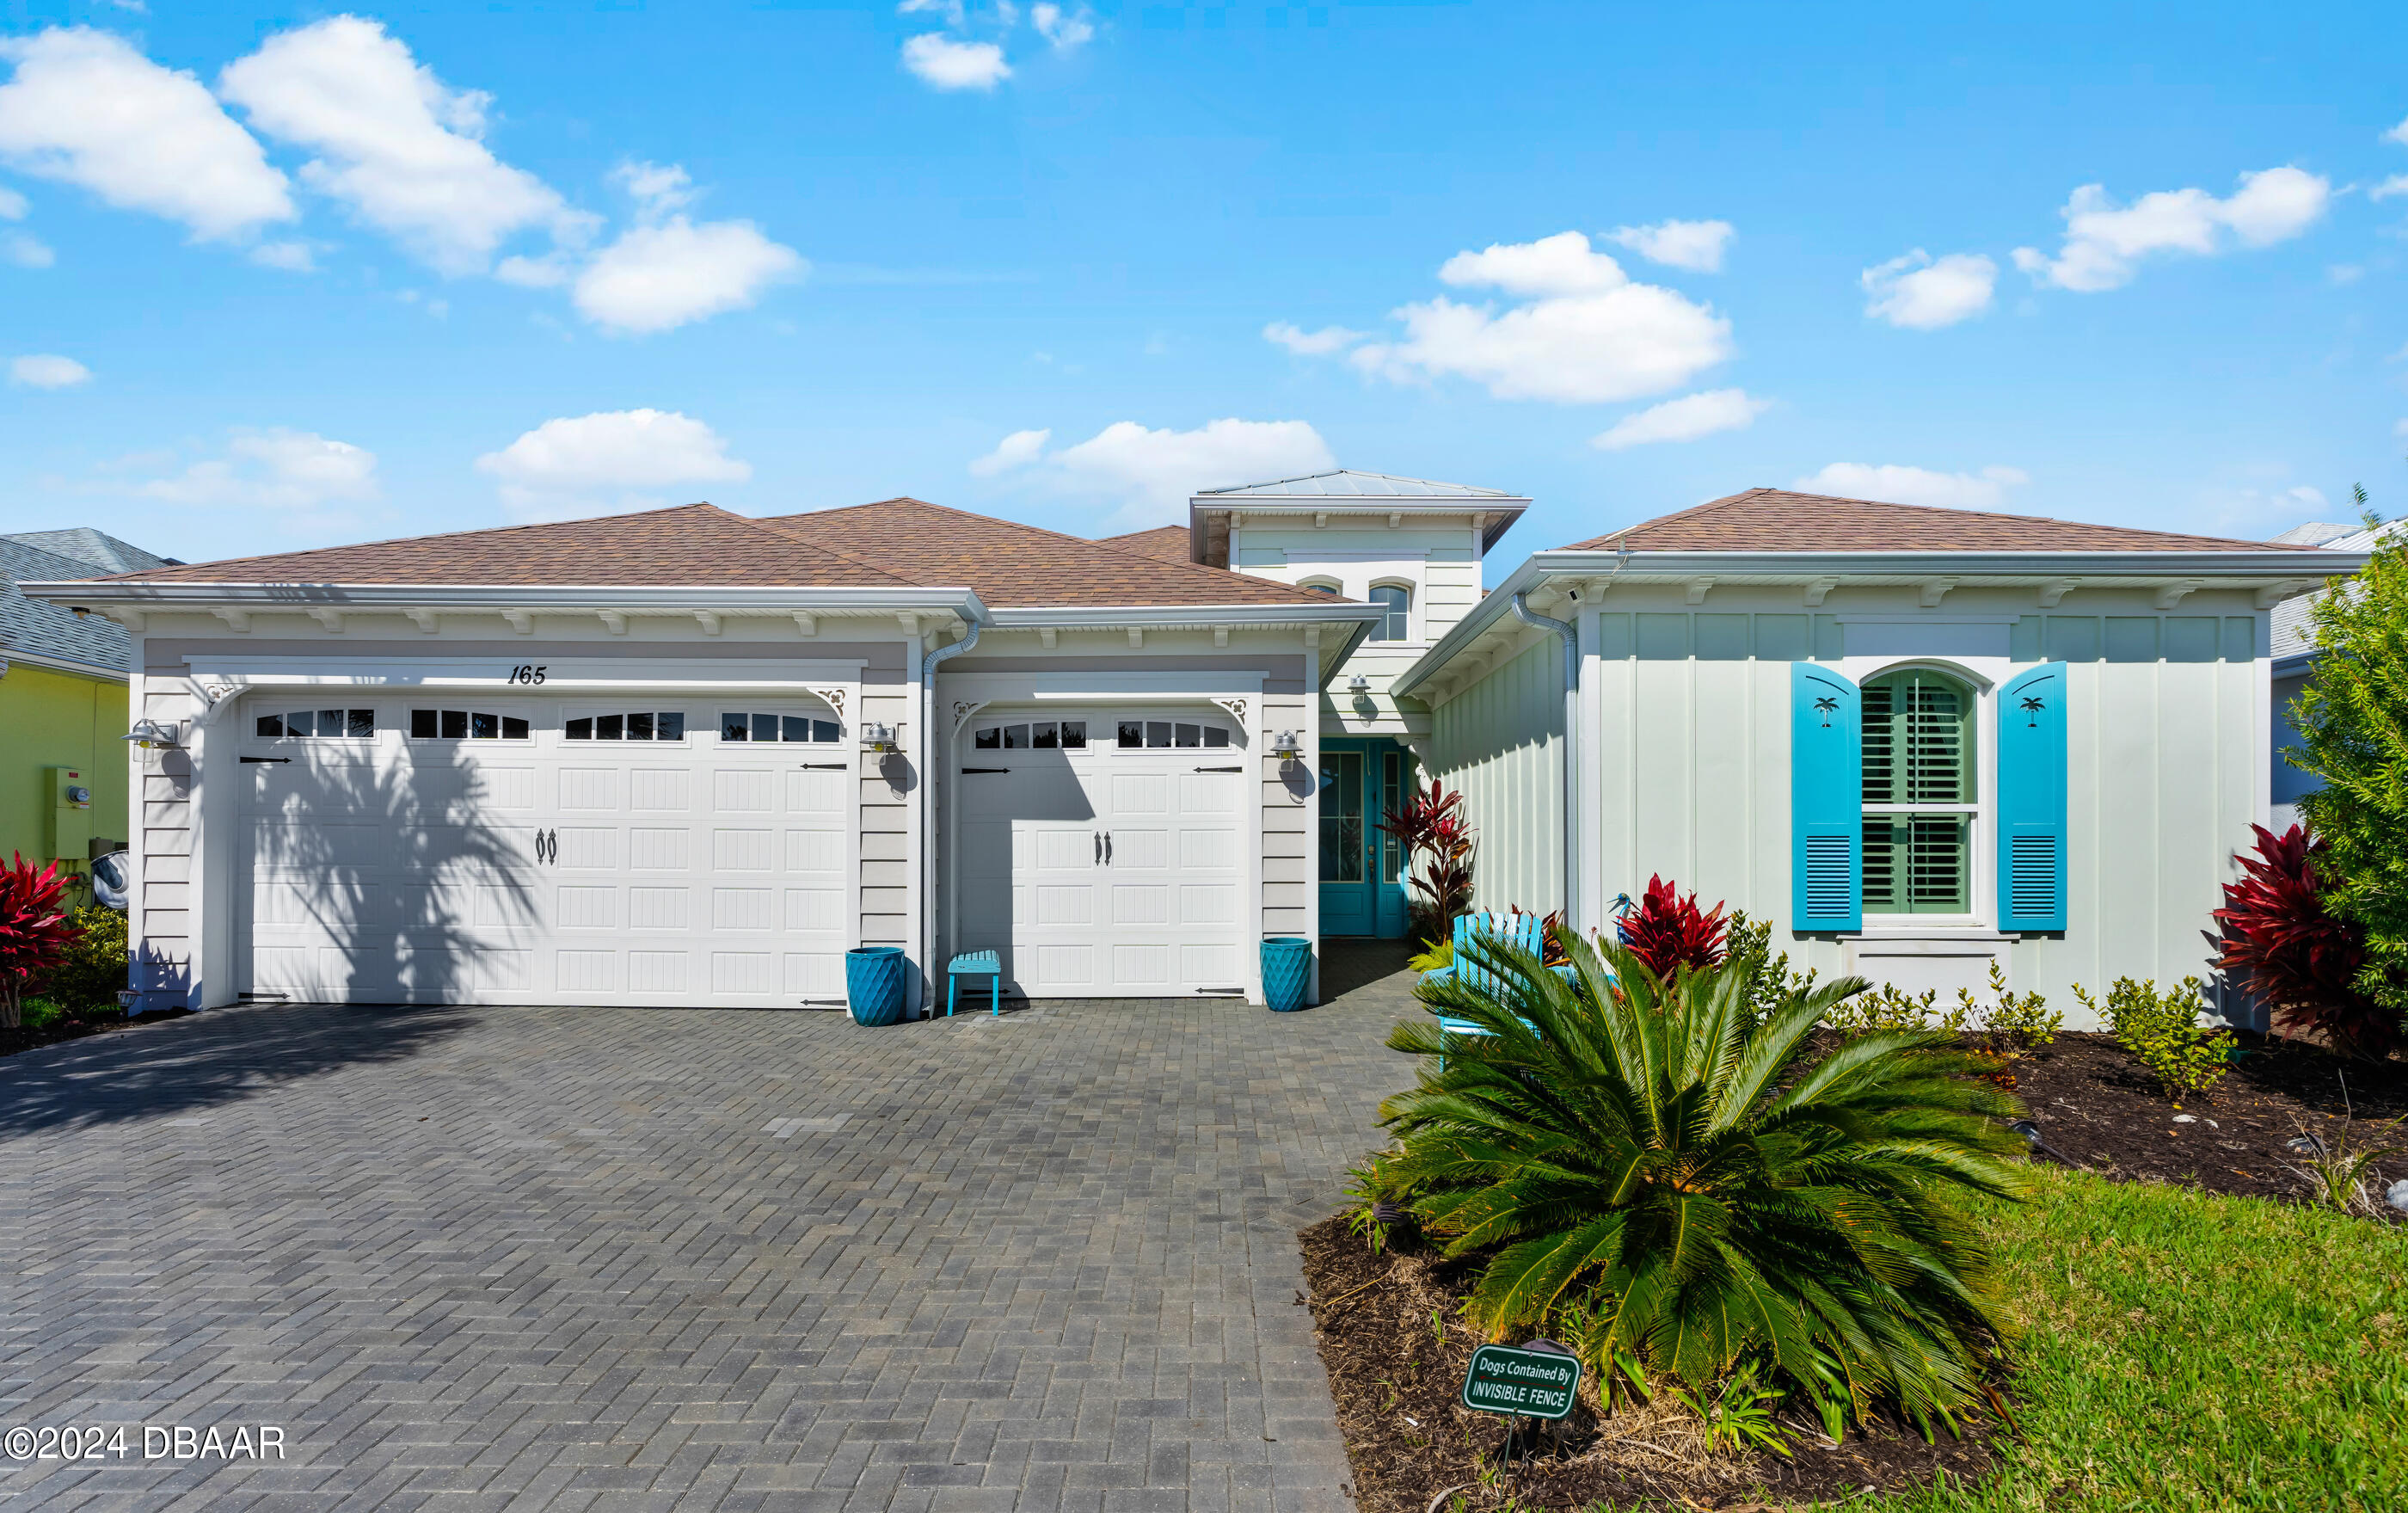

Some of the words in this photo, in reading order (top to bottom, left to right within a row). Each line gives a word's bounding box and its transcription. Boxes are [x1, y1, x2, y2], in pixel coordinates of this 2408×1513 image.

[507, 665, 547, 685] 165
[1479, 1356, 1505, 1375] Dogs
[1507, 1361, 1557, 1381] Contained
[1558, 1368, 1571, 1385] By
[1472, 1381, 1526, 1402] INVISIBLE
[1529, 1388, 1566, 1407] FENCE
